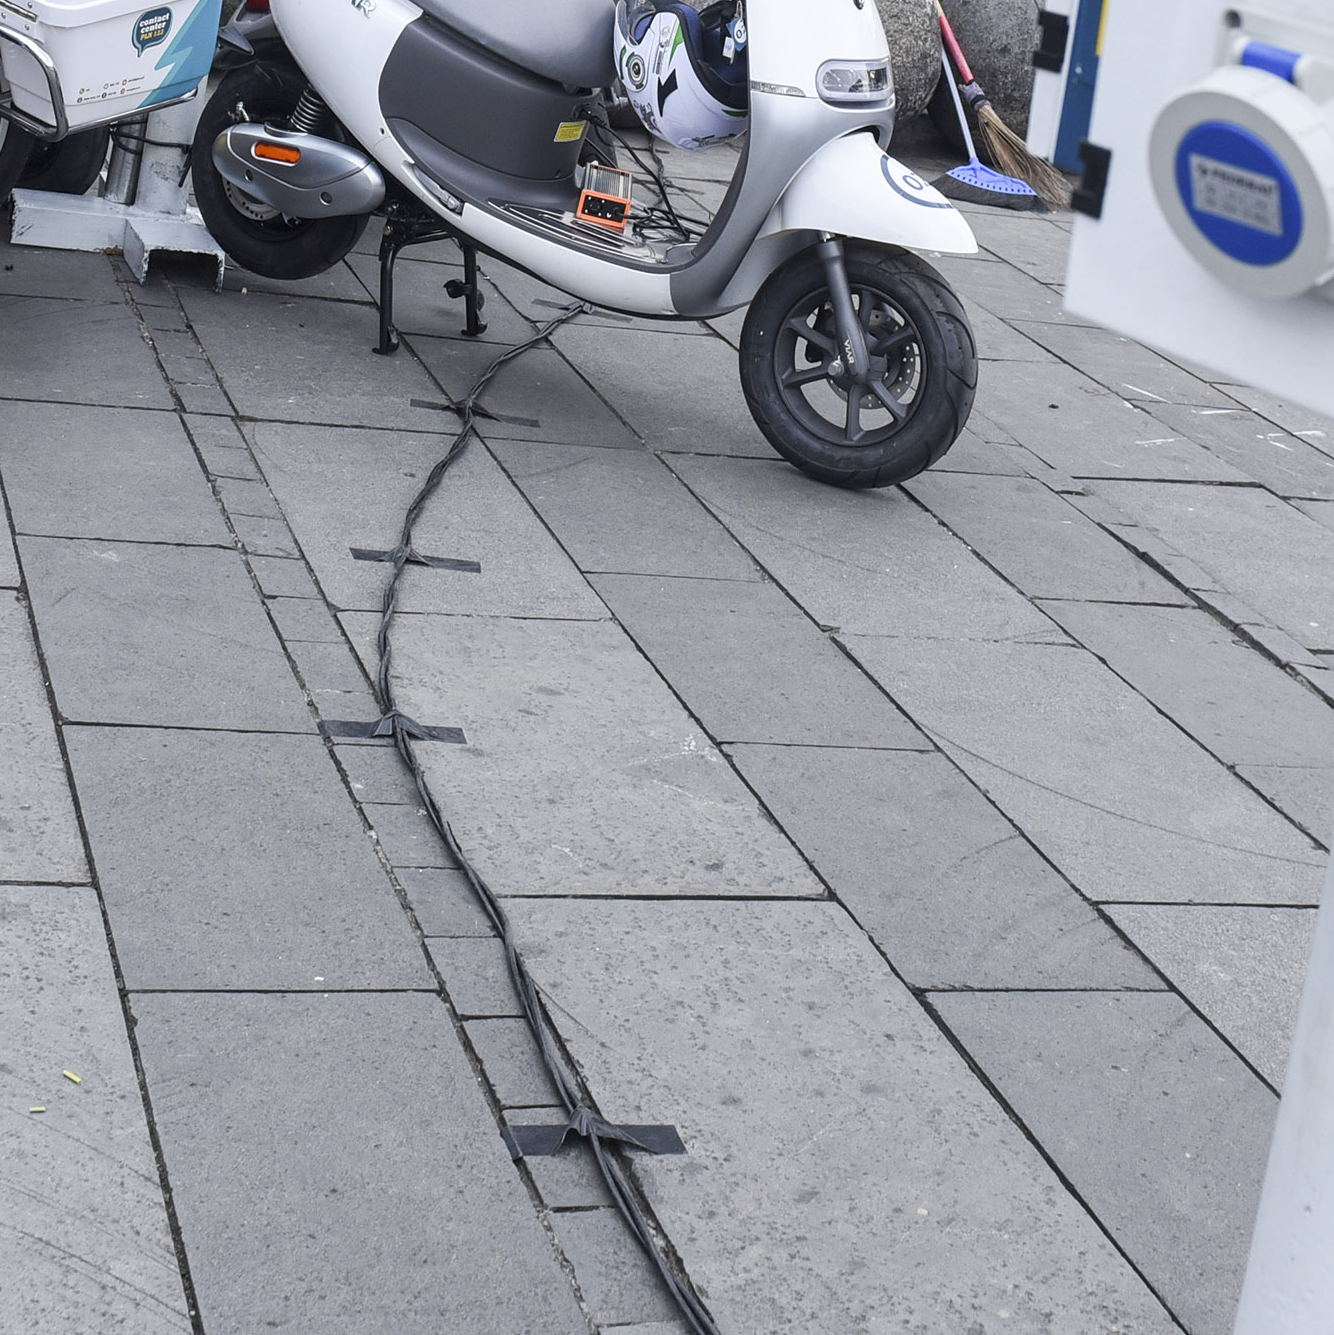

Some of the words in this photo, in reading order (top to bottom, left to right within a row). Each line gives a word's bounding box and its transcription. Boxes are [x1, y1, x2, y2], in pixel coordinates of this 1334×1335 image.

[139, 12, 170, 27] contact
[140, 21, 167, 34] center
[844, 339, 855, 364] VIAR
